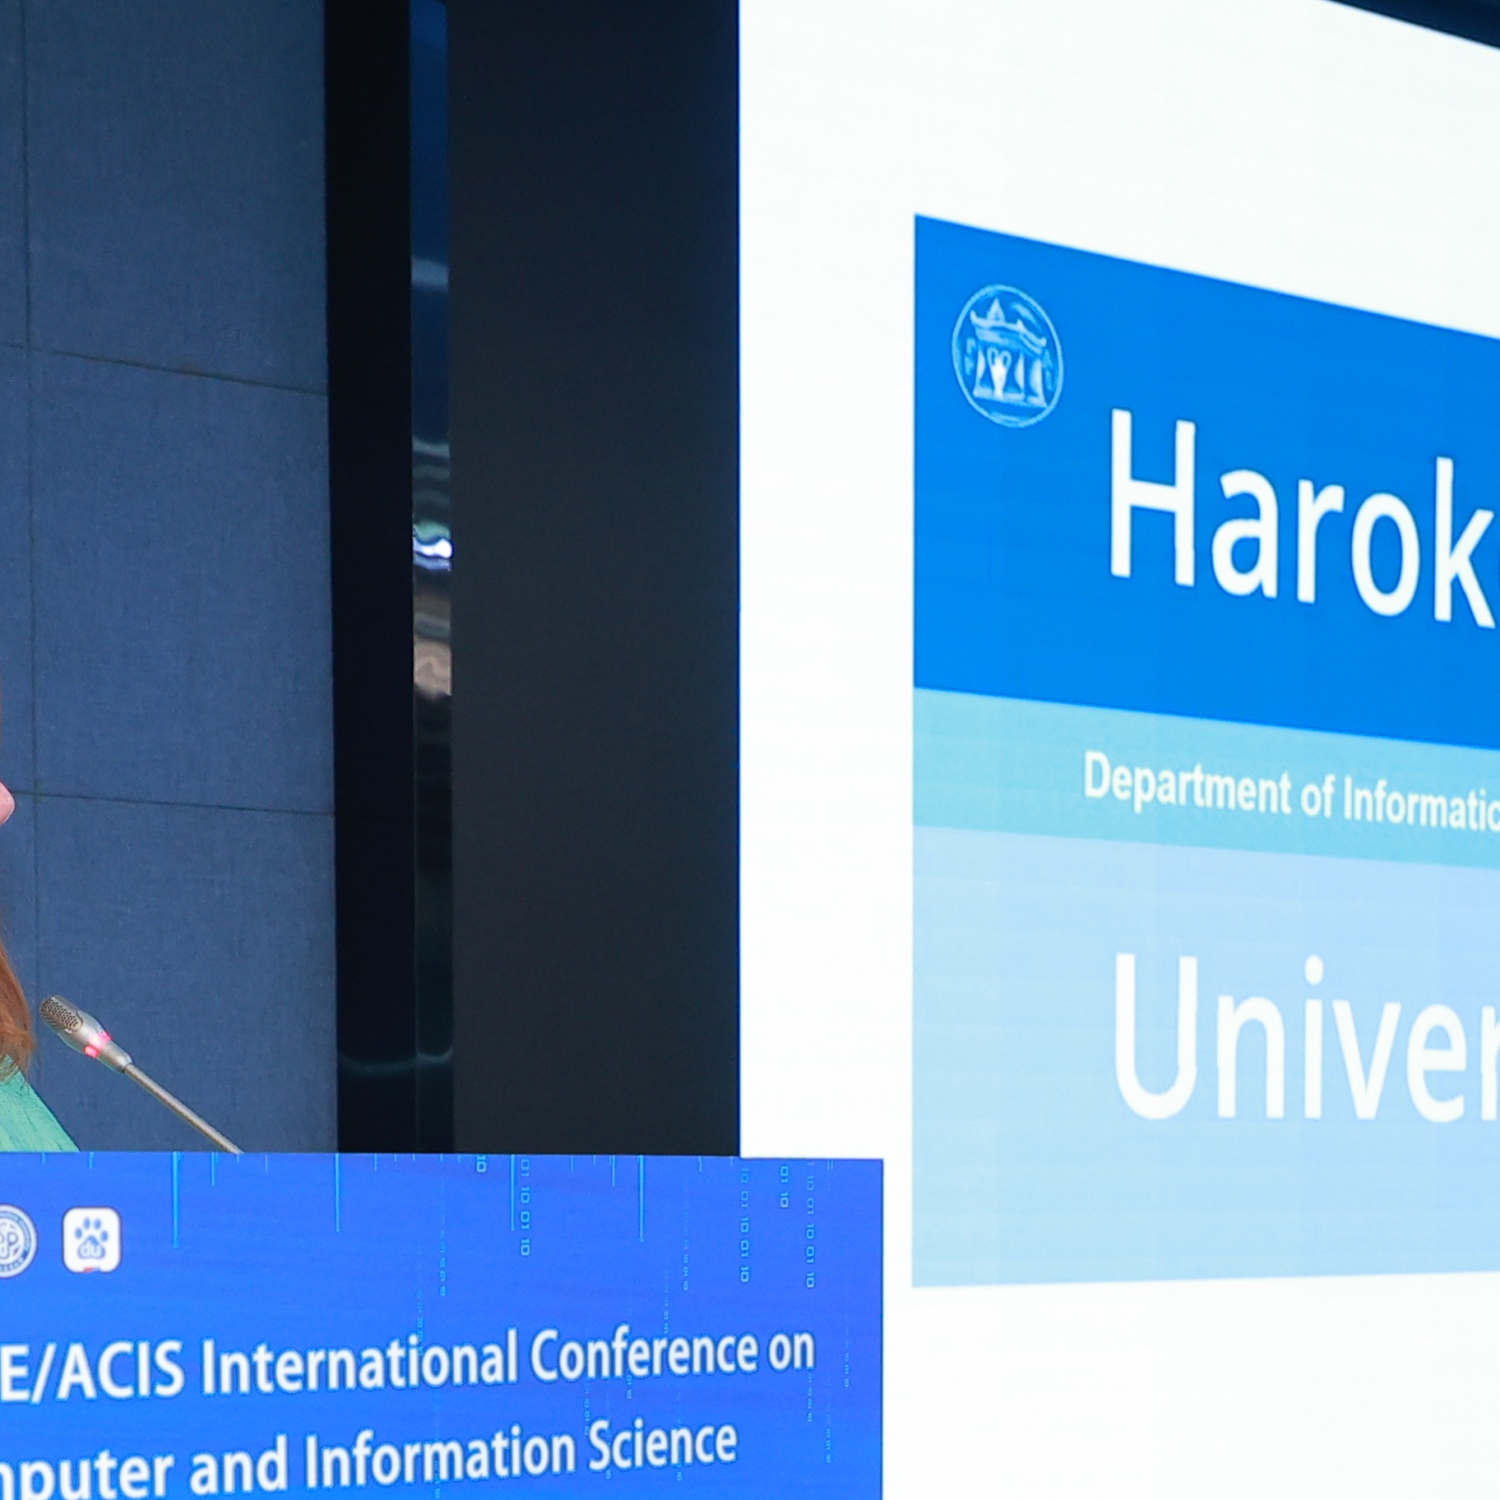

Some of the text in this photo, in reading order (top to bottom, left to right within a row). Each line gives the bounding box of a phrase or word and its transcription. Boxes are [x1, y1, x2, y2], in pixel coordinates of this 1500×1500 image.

[1084, 750, 1292, 815] Department
[1300, 773, 1336, 819] of
[202, 1328, 517, 1394] International
[530, 1324, 758, 1380] Conference
[769, 1333, 815, 1370] on
[190, 1434, 288, 1496] and
[306, 1424, 576, 1489] Information
[589, 1418, 738, 1470] Science
